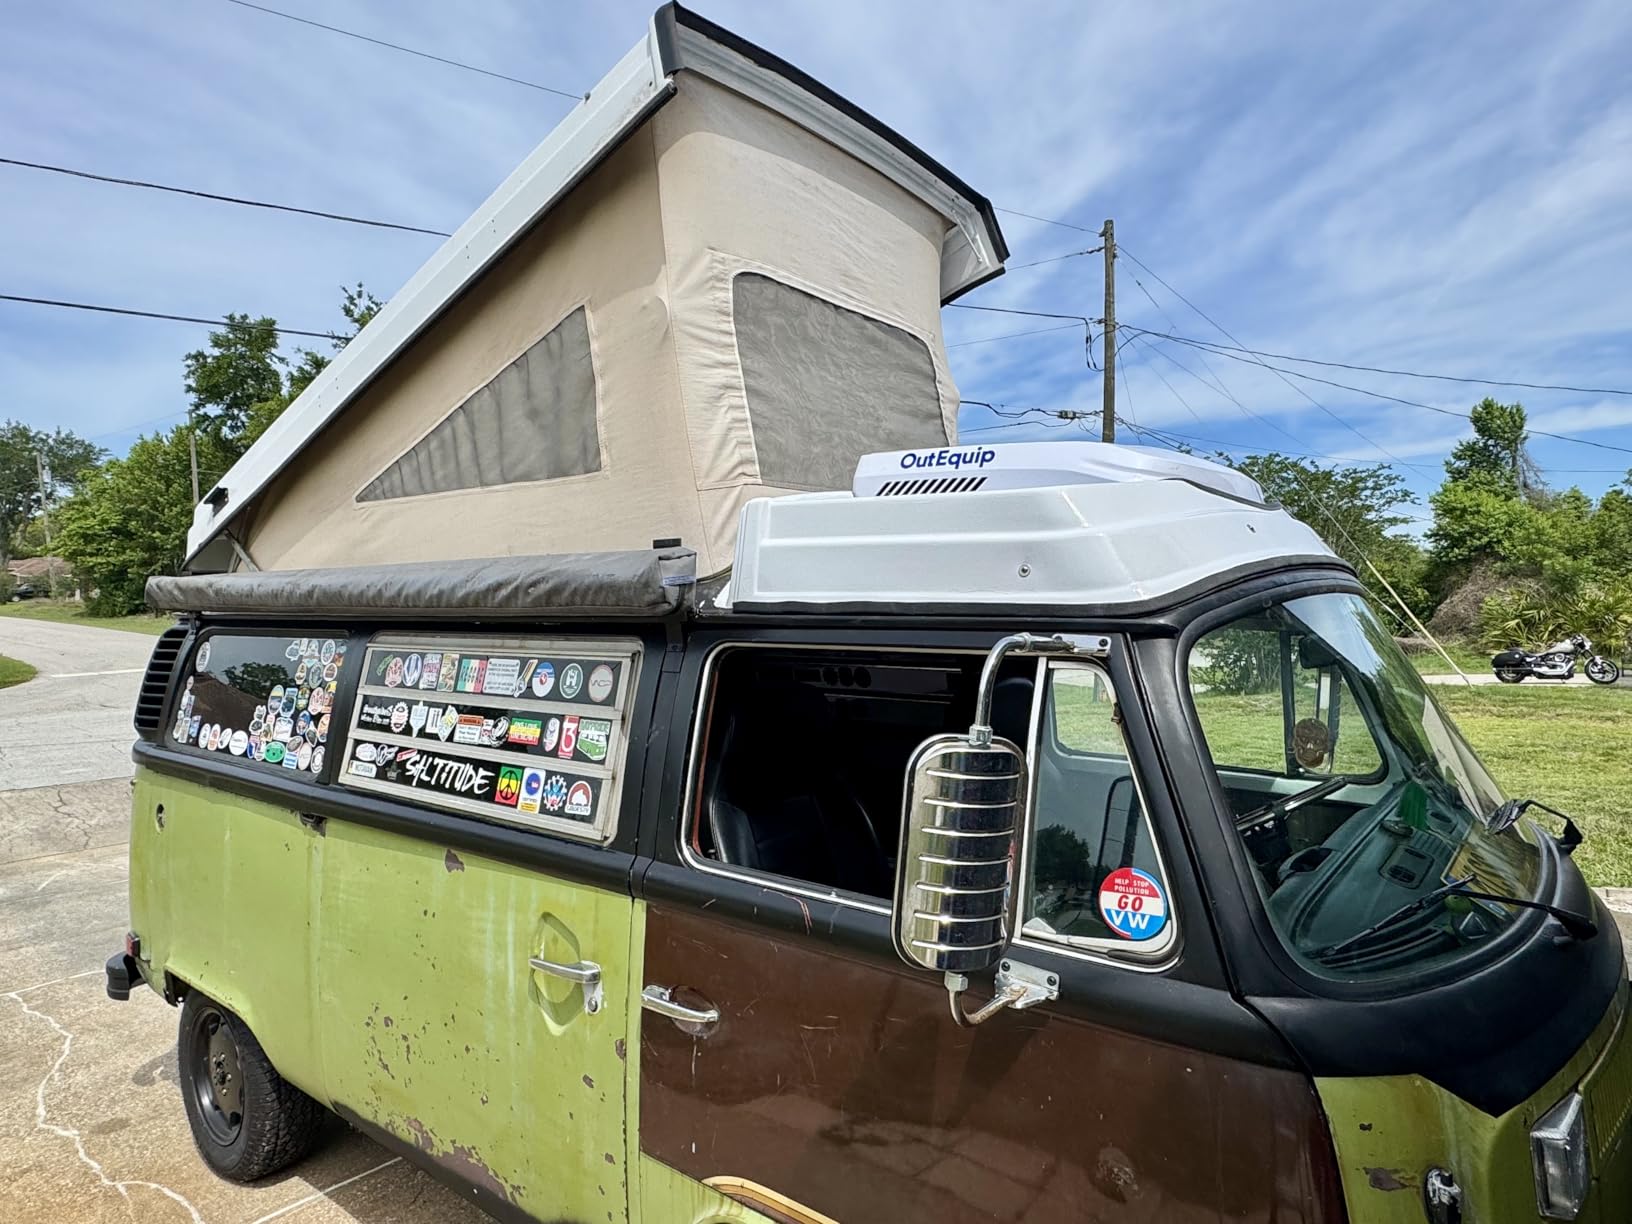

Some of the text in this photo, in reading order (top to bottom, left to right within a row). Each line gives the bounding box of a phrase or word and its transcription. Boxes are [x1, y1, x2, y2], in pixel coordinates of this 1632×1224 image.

[900, 447, 995, 469] OutEquip
[1114, 885, 1149, 895] POLLUTION
[1117, 894, 1143, 912] GO
[1110, 909, 1150, 930] VW
